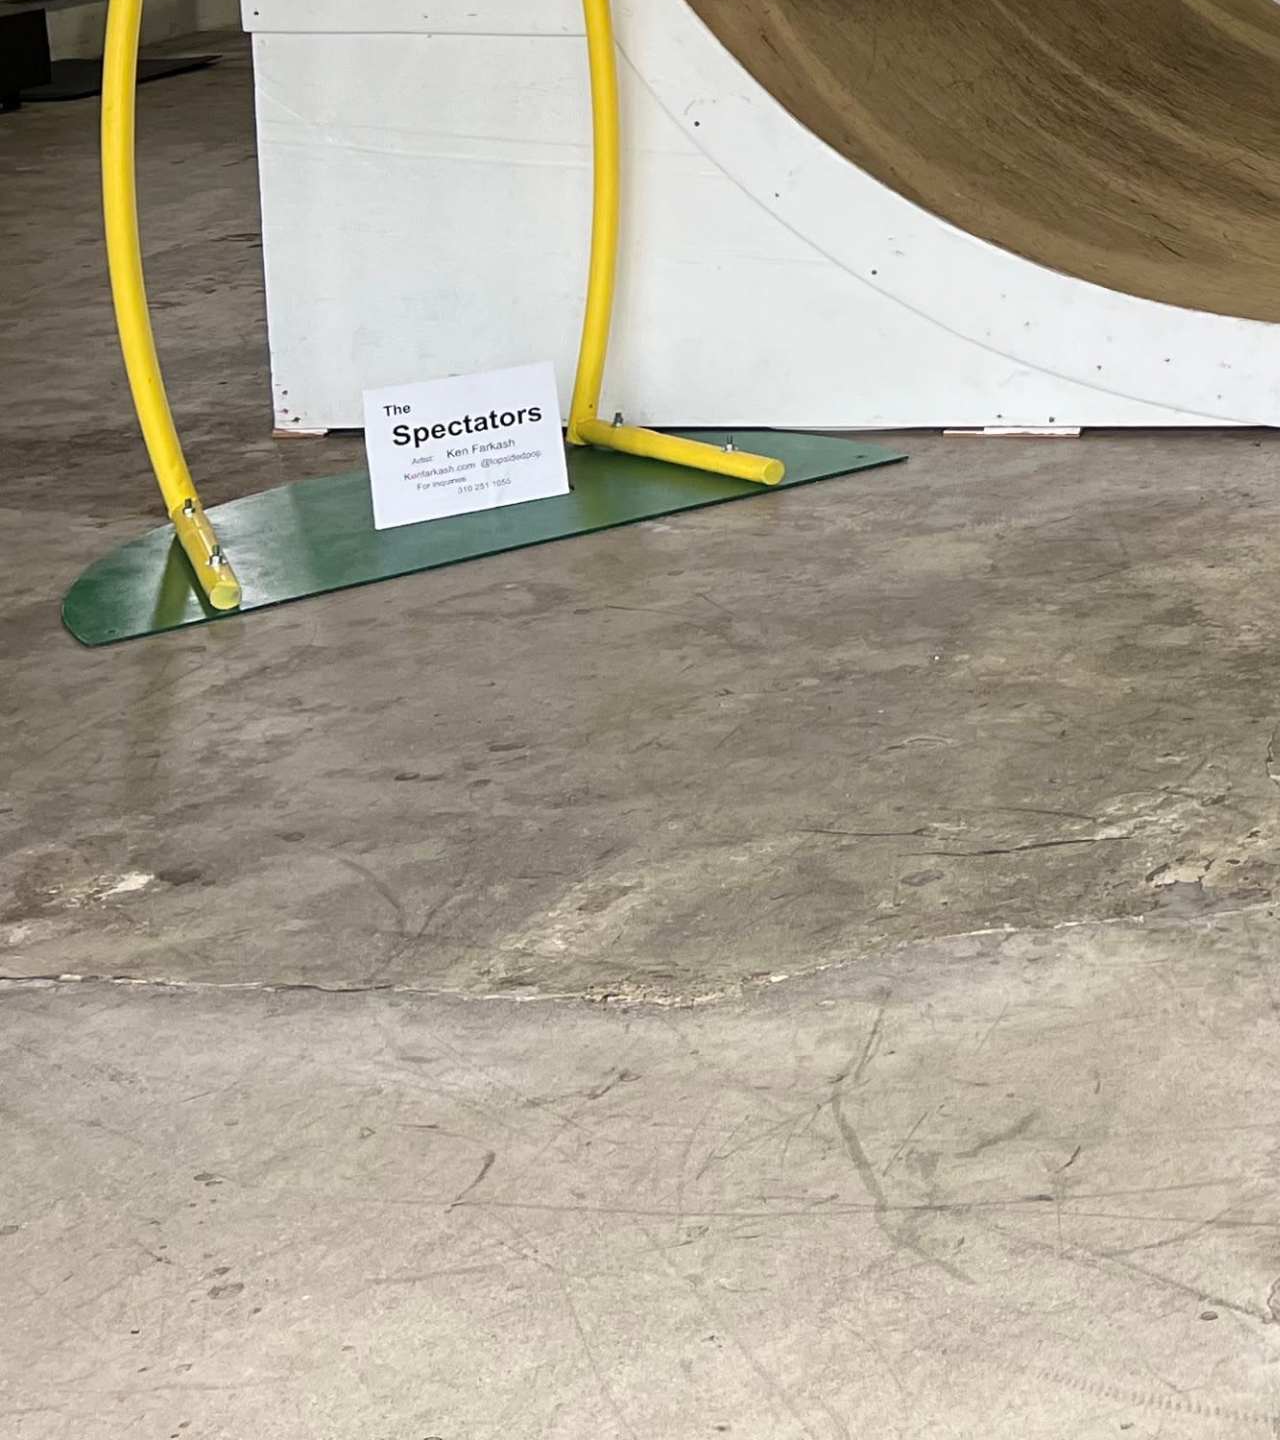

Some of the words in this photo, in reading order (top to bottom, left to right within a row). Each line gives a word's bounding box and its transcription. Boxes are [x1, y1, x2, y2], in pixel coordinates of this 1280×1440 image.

[383, 405, 411, 417] The
[393, 407, 542, 448] Spectators
[447, 447, 469, 459] Ken
[472, 438, 515, 454] Farkash
[416, 482, 431, 491] For
